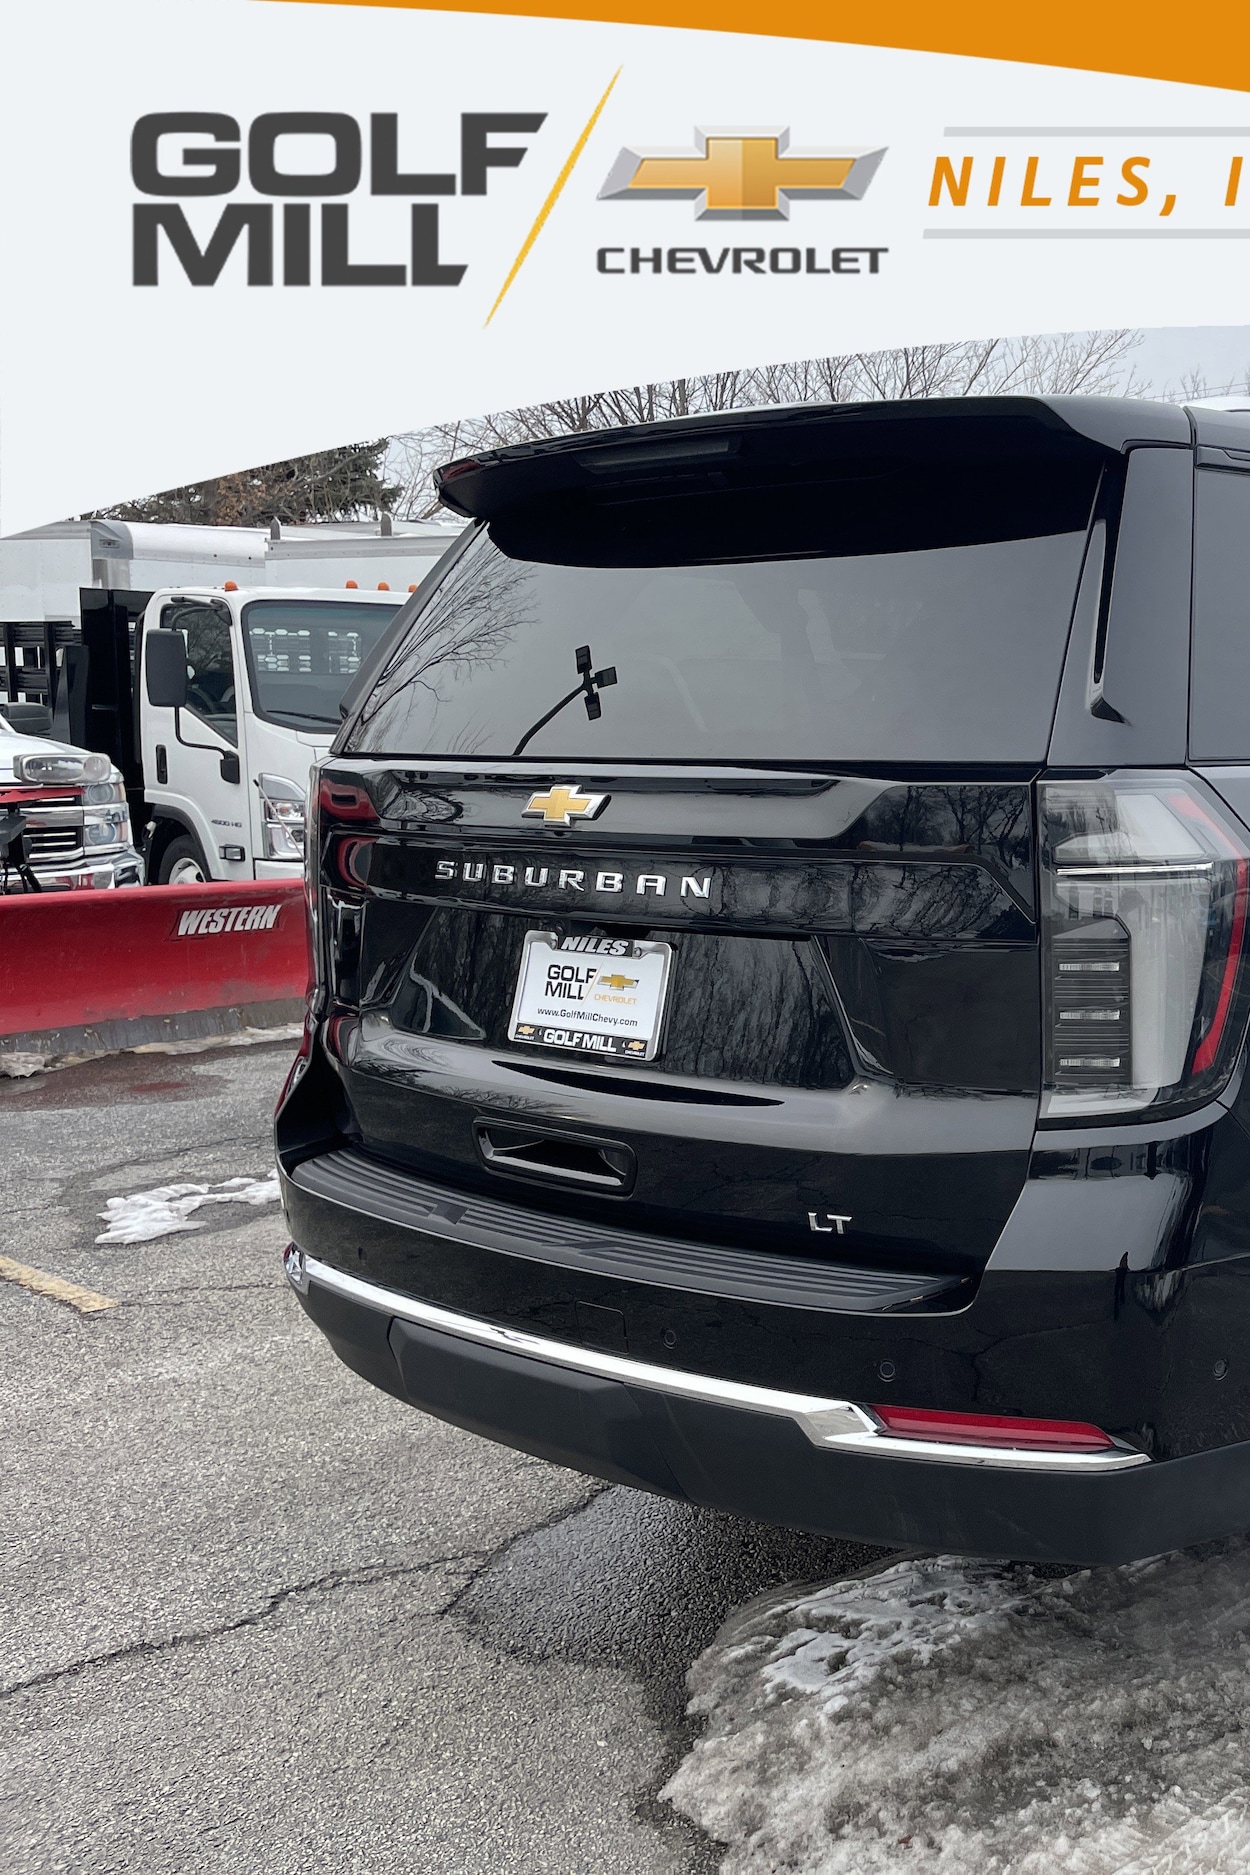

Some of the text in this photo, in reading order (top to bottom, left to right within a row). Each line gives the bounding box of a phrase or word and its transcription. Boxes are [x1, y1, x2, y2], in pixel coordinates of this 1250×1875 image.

[435, 860, 712, 899] SUBURBAN
[178, 904, 282, 936] WESTERN
[561, 936, 629, 956] NILES
[547, 964, 598, 984] GOLF
[544, 981, 585, 1000] MILL
[594, 993, 637, 1005] CHEVROLET
[537, 1007, 638, 1027] www.GolfMillChevy.com
[543, 1029, 617, 1052] GOLF MILL
[807, 1212, 853, 1235] LT
